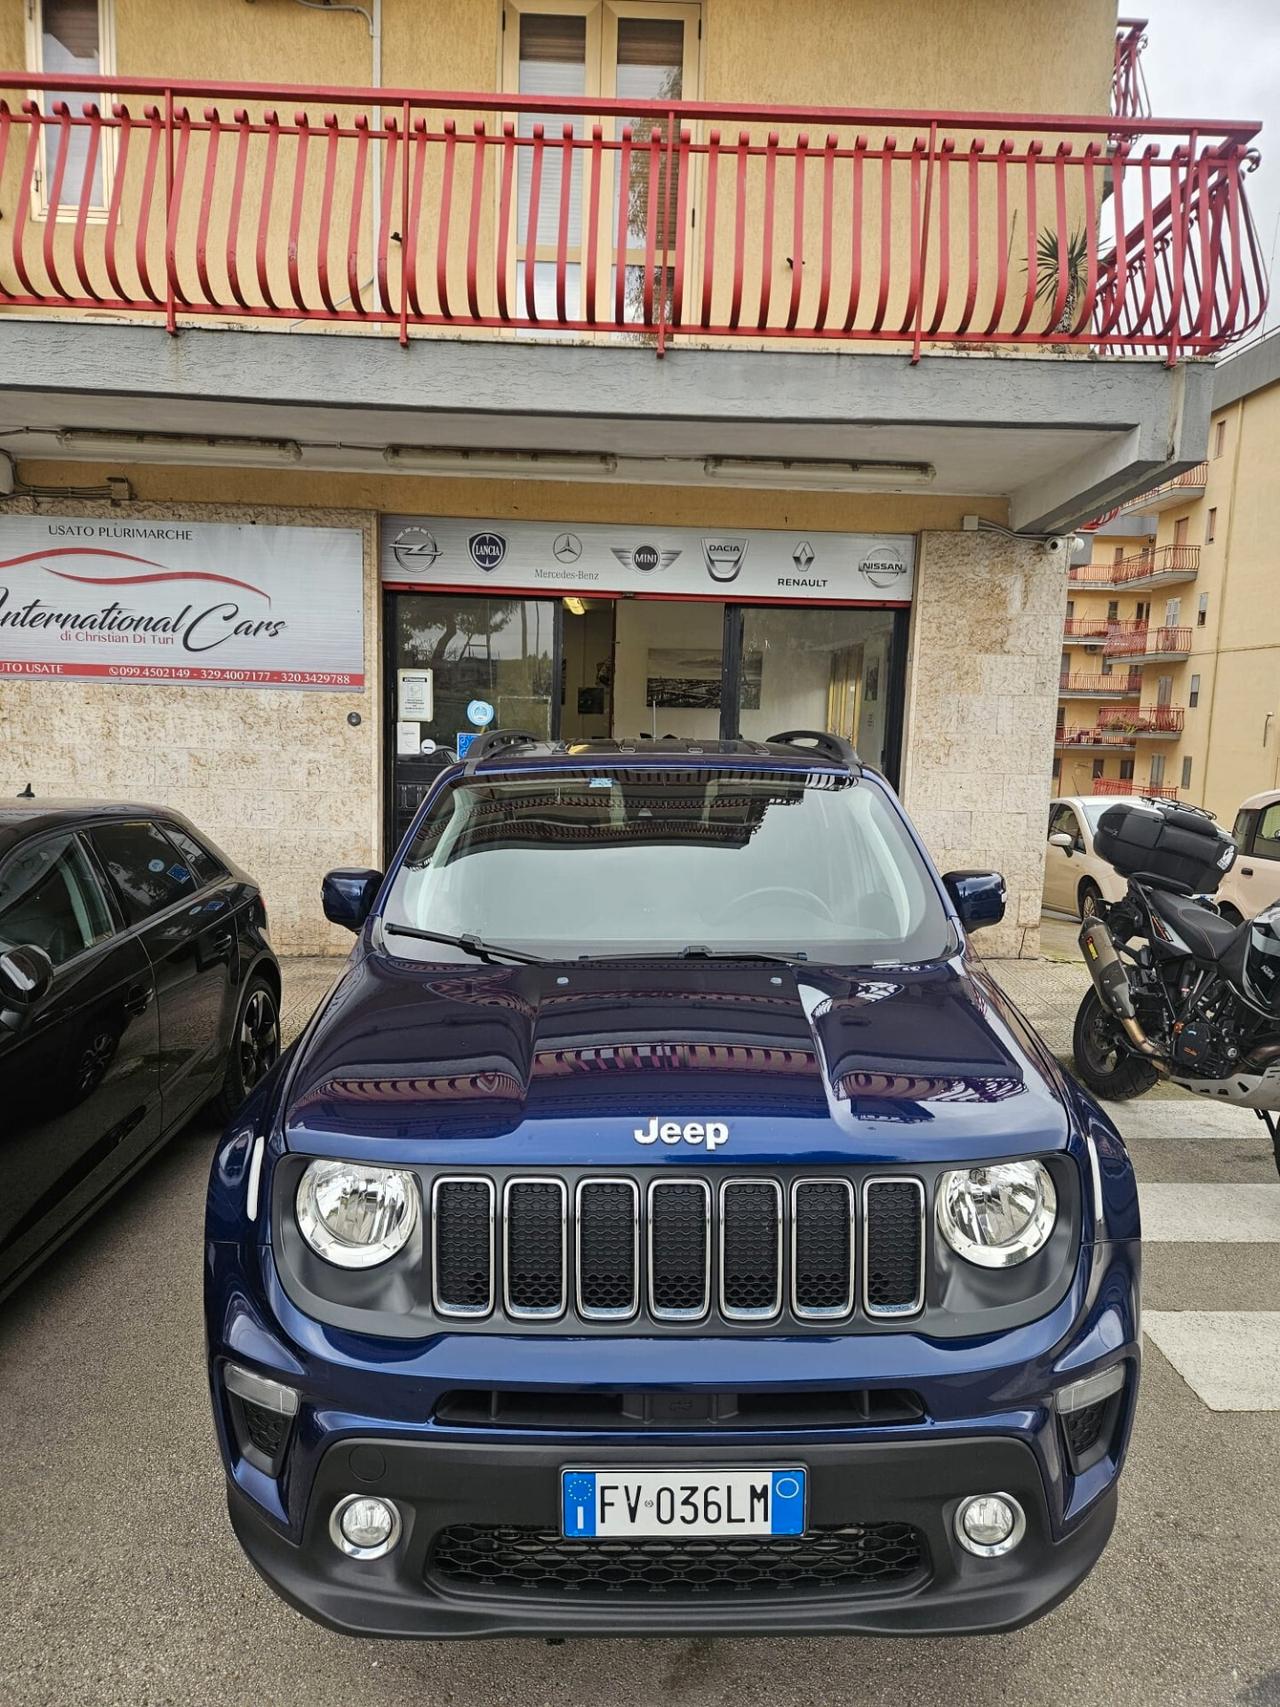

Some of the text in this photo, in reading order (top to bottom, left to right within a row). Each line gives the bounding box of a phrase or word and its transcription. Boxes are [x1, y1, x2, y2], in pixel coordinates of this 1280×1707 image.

[48, 525, 193, 541] USATO PLURIMARCHE
[475, 543, 500, 556] LANCIA
[708, 544, 740, 552] DACIA
[635, 551, 658, 565] MINI
[862, 562, 903, 572] NISSAN
[534, 568, 600, 581] Mercedes-Benz
[777, 578, 829, 588] RENAULT
[182, 602, 288, 652] Cars
[60, 631, 174, 645] di Christian Di Turi
[26, 663, 64, 674] USATE
[119, 666, 190, 678] 099.4502149
[200, 669, 270, 681] 329.4007177
[281, 672, 350, 684] 320.3429788
[633, 1116, 729, 1151] Jeep
[599, 1484, 769, 1525] FV 036LM
